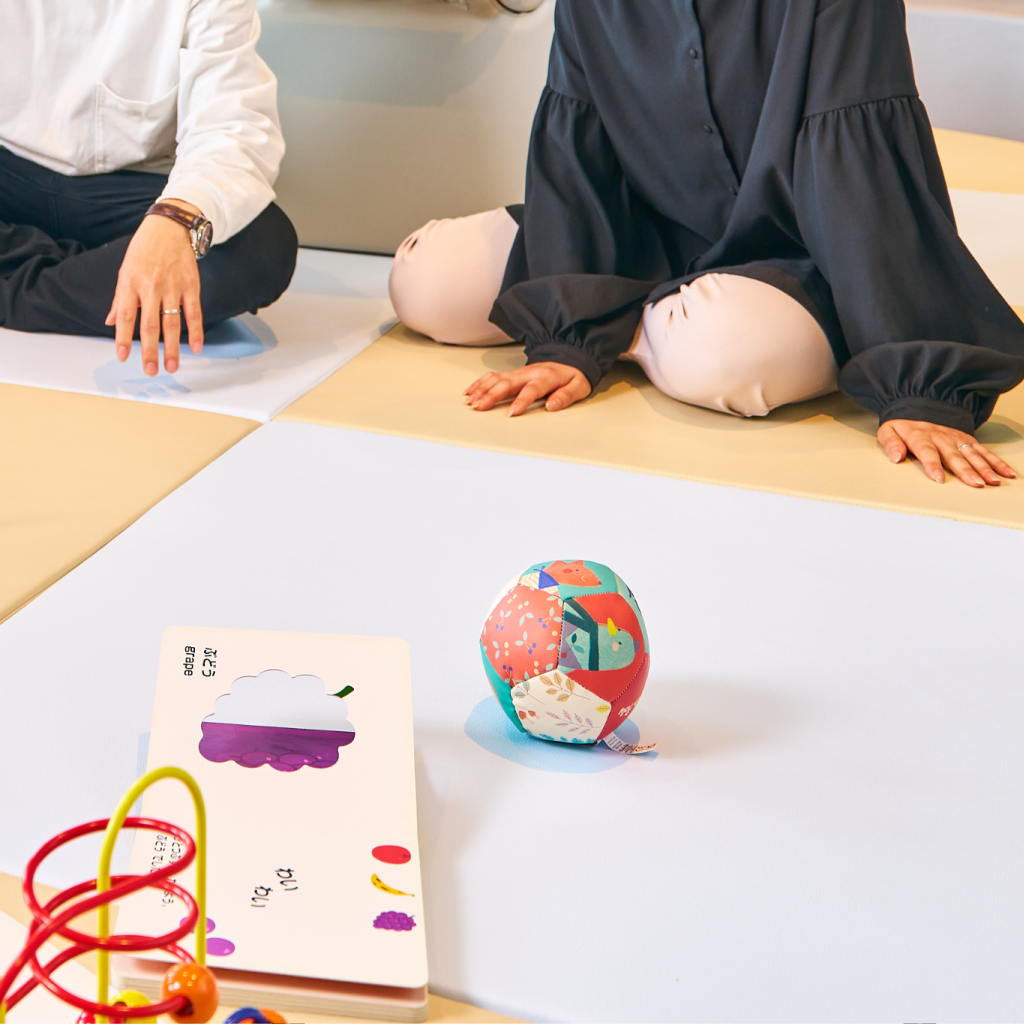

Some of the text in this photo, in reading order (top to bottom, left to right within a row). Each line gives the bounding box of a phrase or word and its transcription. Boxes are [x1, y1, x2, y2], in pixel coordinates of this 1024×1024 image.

[182, 645, 196, 677] grape
[201, 647, 218, 678] ぶどう
